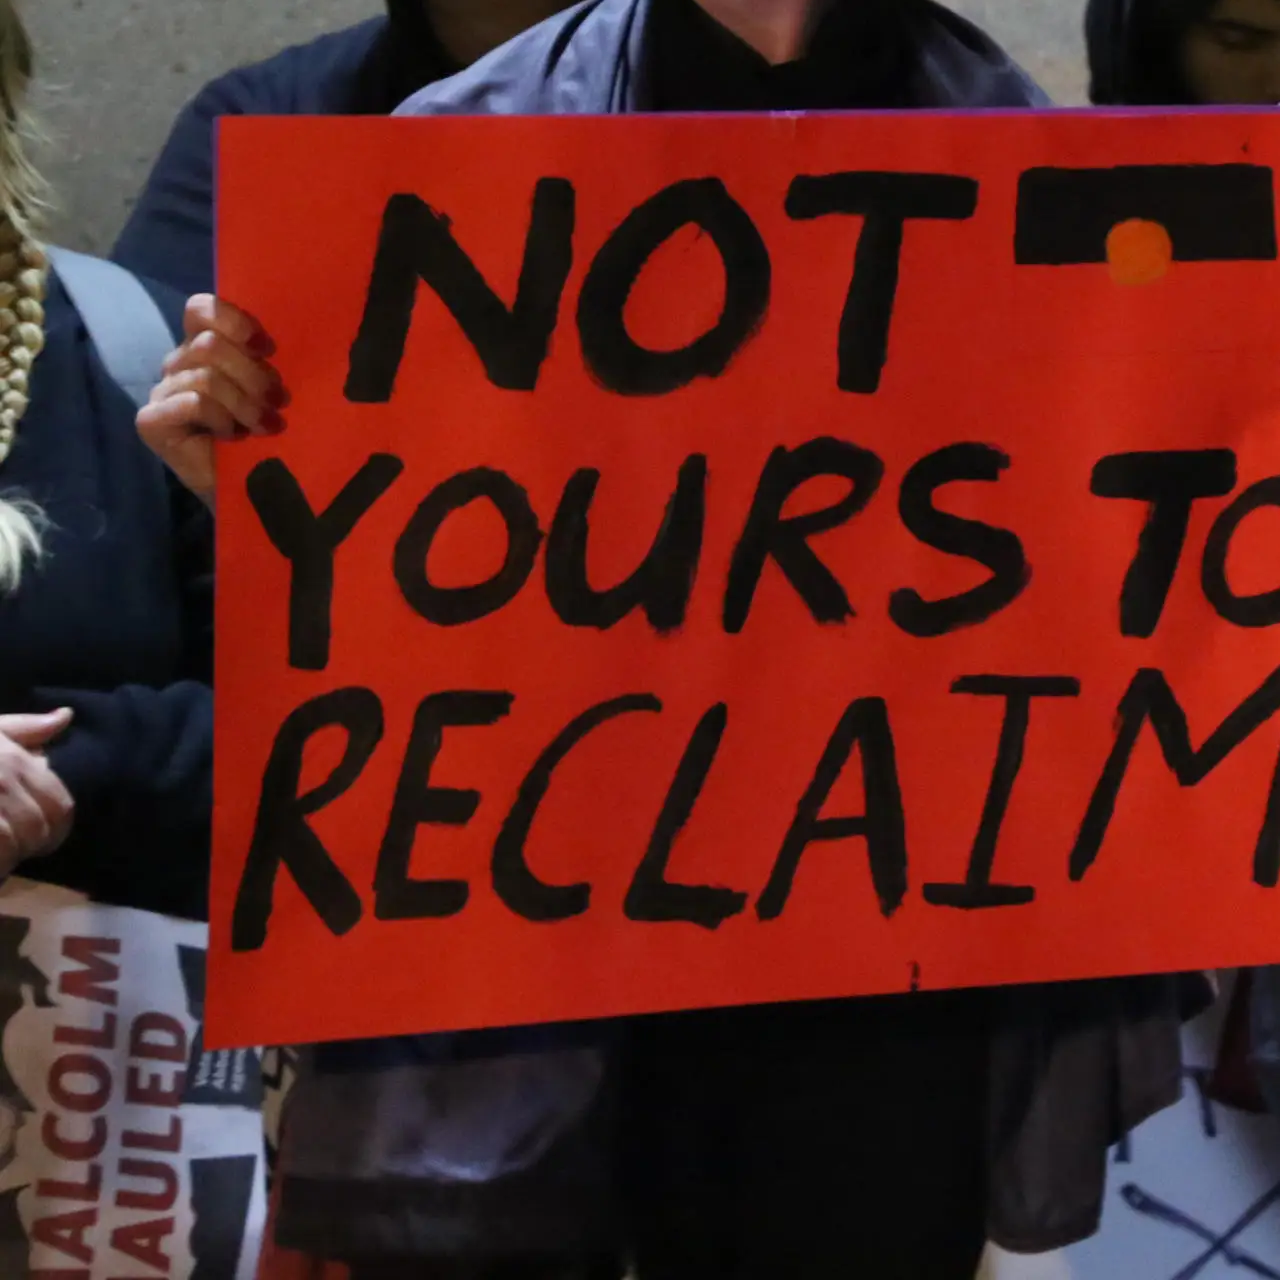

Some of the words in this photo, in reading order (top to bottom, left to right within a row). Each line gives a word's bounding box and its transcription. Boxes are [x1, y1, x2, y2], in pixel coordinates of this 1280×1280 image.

[343, 169, 979, 402] NOT
[246, 435, 1033, 670] YOURS
[29, 936, 121, 1280] ALCOLM
[106, 1011, 187, 1280] AULED
